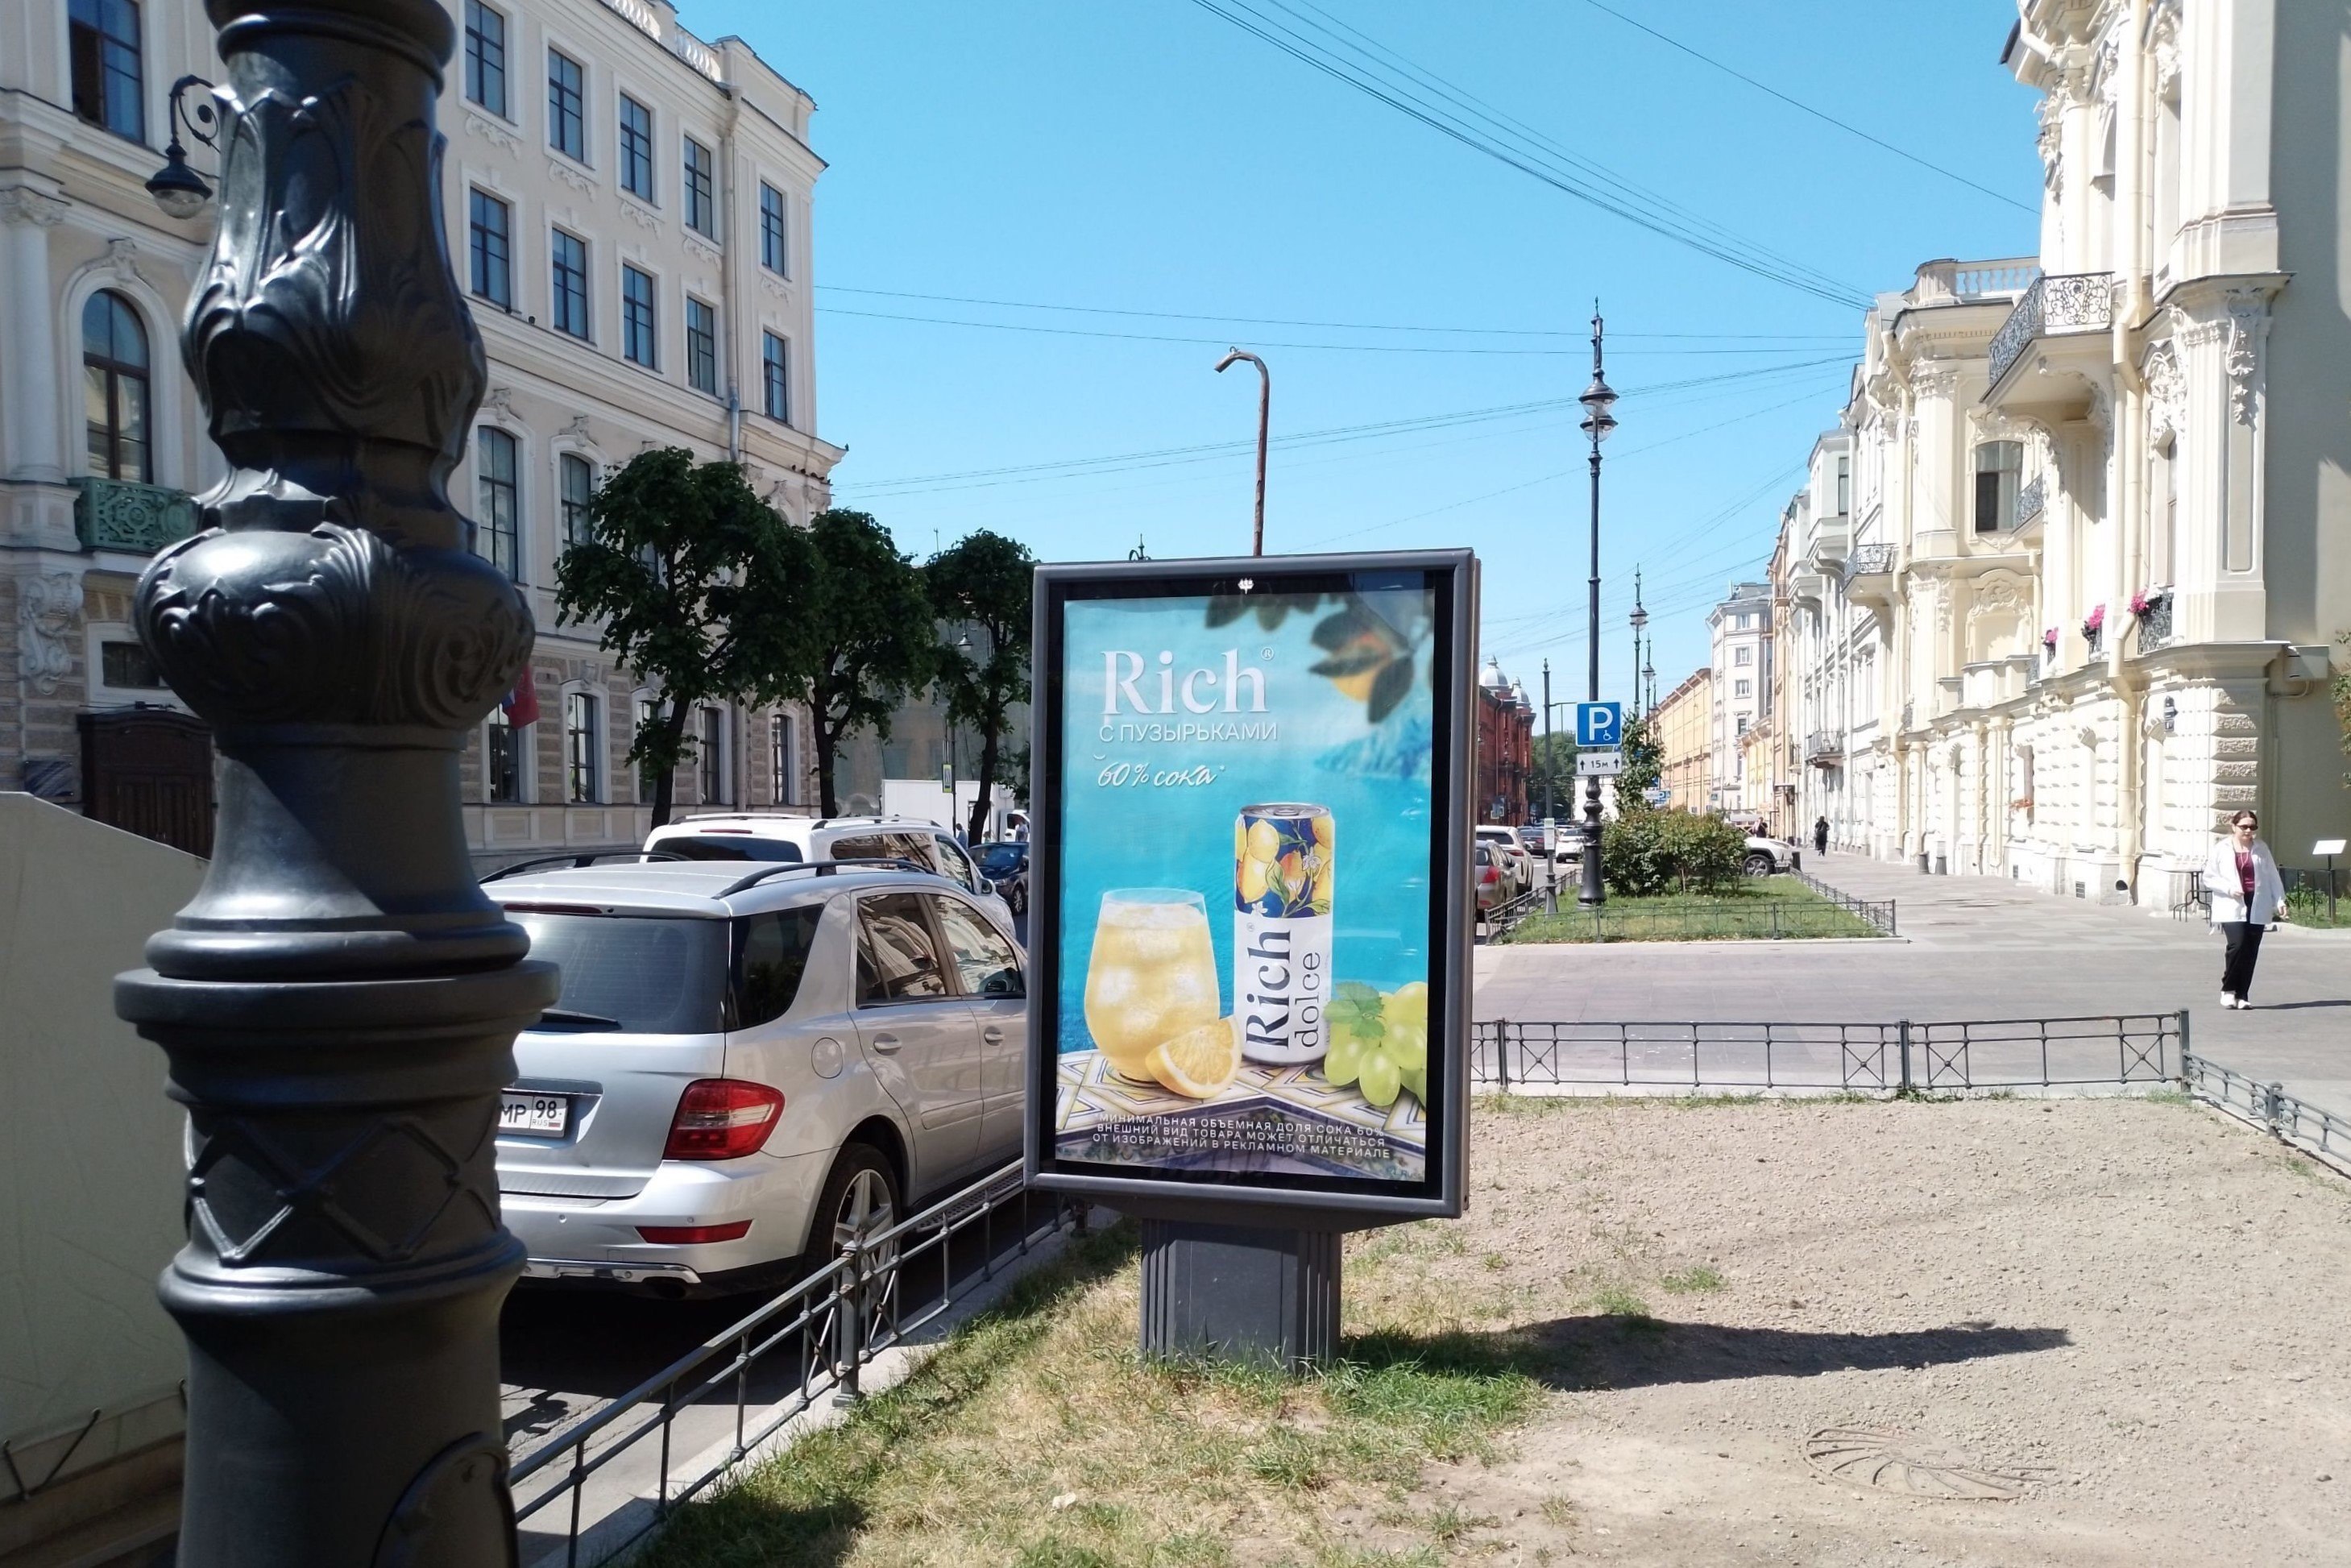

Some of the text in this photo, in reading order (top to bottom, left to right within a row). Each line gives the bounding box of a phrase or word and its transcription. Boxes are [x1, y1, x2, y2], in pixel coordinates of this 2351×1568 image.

[1100, 722, 1278, 742] С ПУЗЫРЬКАМИ
[1589, 707, 1613, 740] P
[1097, 761, 1150, 787] 60%
[1246, 930, 1291, 1049] Rich
[1294, 952, 1321, 1048] dolce
[535, 1099, 557, 1118] 98
[532, 1118, 548, 1126] RUS
[1200, 1118, 1271, 1130] ОБЪЕМНАЯ
[1275, 1122, 1311, 1133] ДОЛЯ
[1316, 1125, 1352, 1135] СОКА
[1357, 1127, 1384, 1137] 60%
[1093, 1133, 1391, 1159] ОТ ИЗОБРАЖЕНИЙ В РЕКЛАМНОМ МАТЕРИАЛЕ
[1097, 1124, 1385, 1147] ВНЕШНИЙ ВИД ТОВАРА МОЖЕТ ОТЛИЧАТЬСЯ
